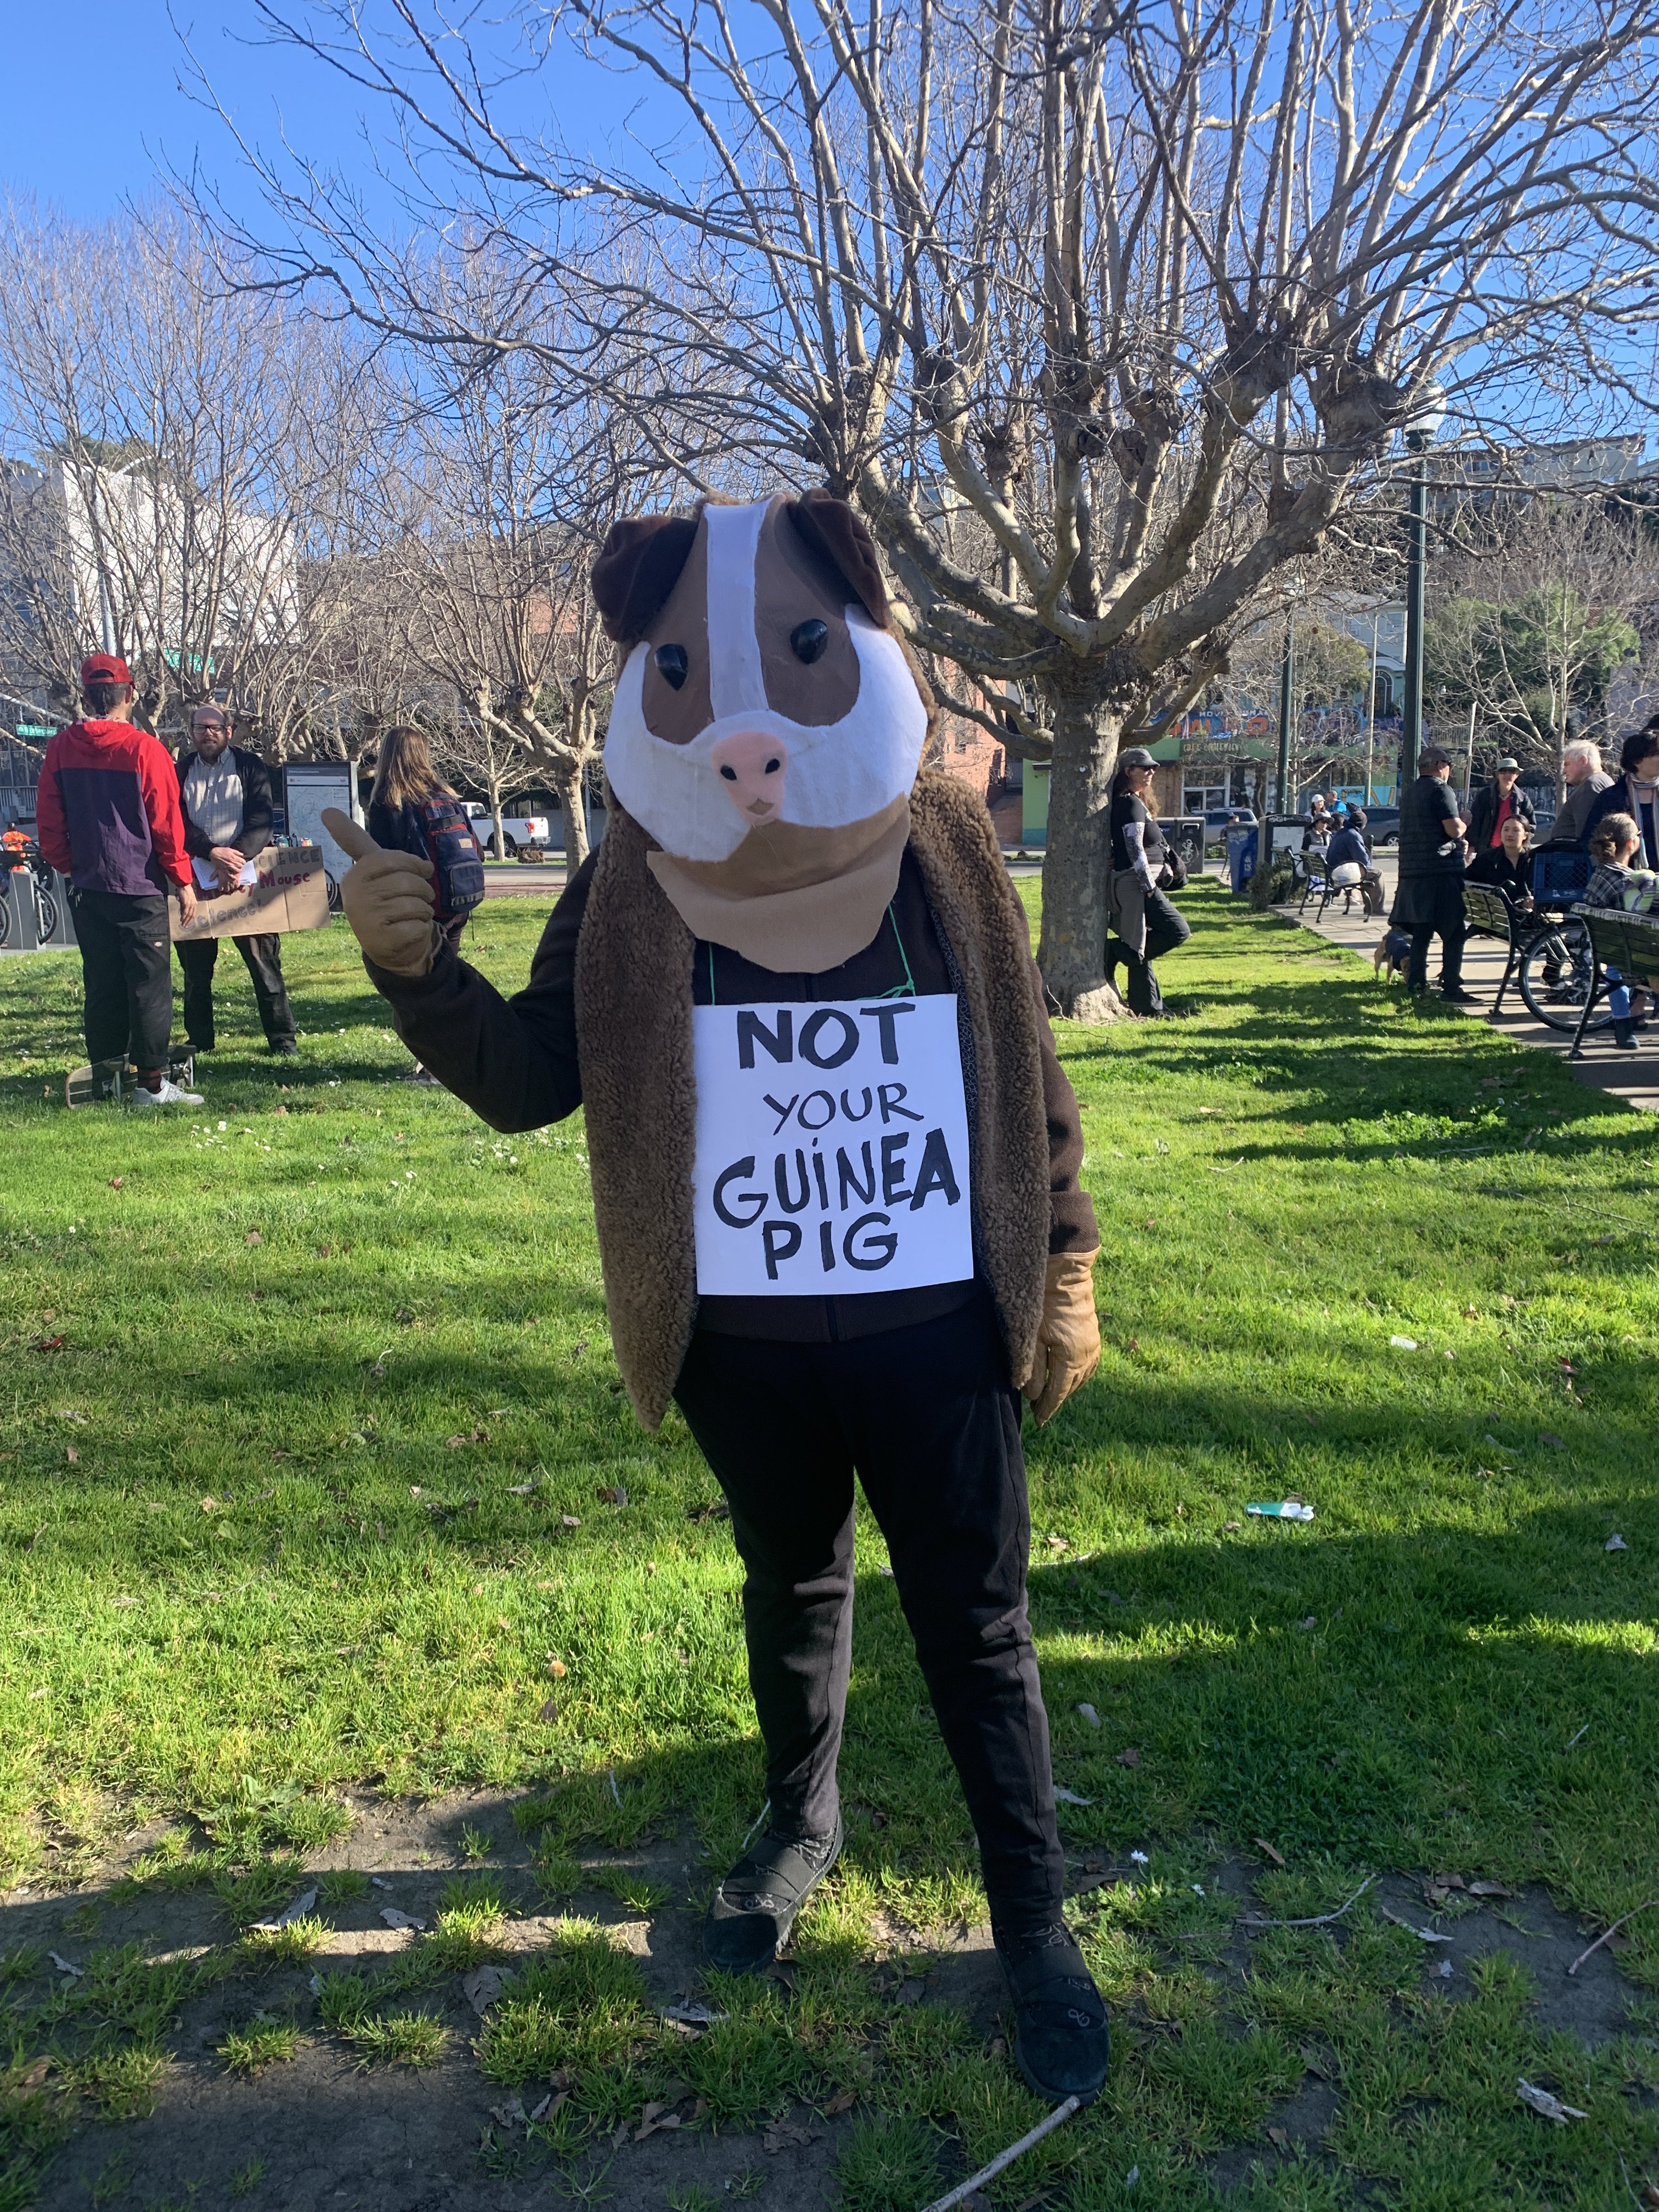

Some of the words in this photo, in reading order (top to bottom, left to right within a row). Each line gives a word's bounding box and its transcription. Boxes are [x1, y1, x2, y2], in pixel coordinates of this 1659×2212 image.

[259, 870, 311, 889] Mouse
[737, 1002, 916, 1069] NOT
[763, 1082, 924, 1136] YOUR
[762, 1212, 899, 1280] PIG
